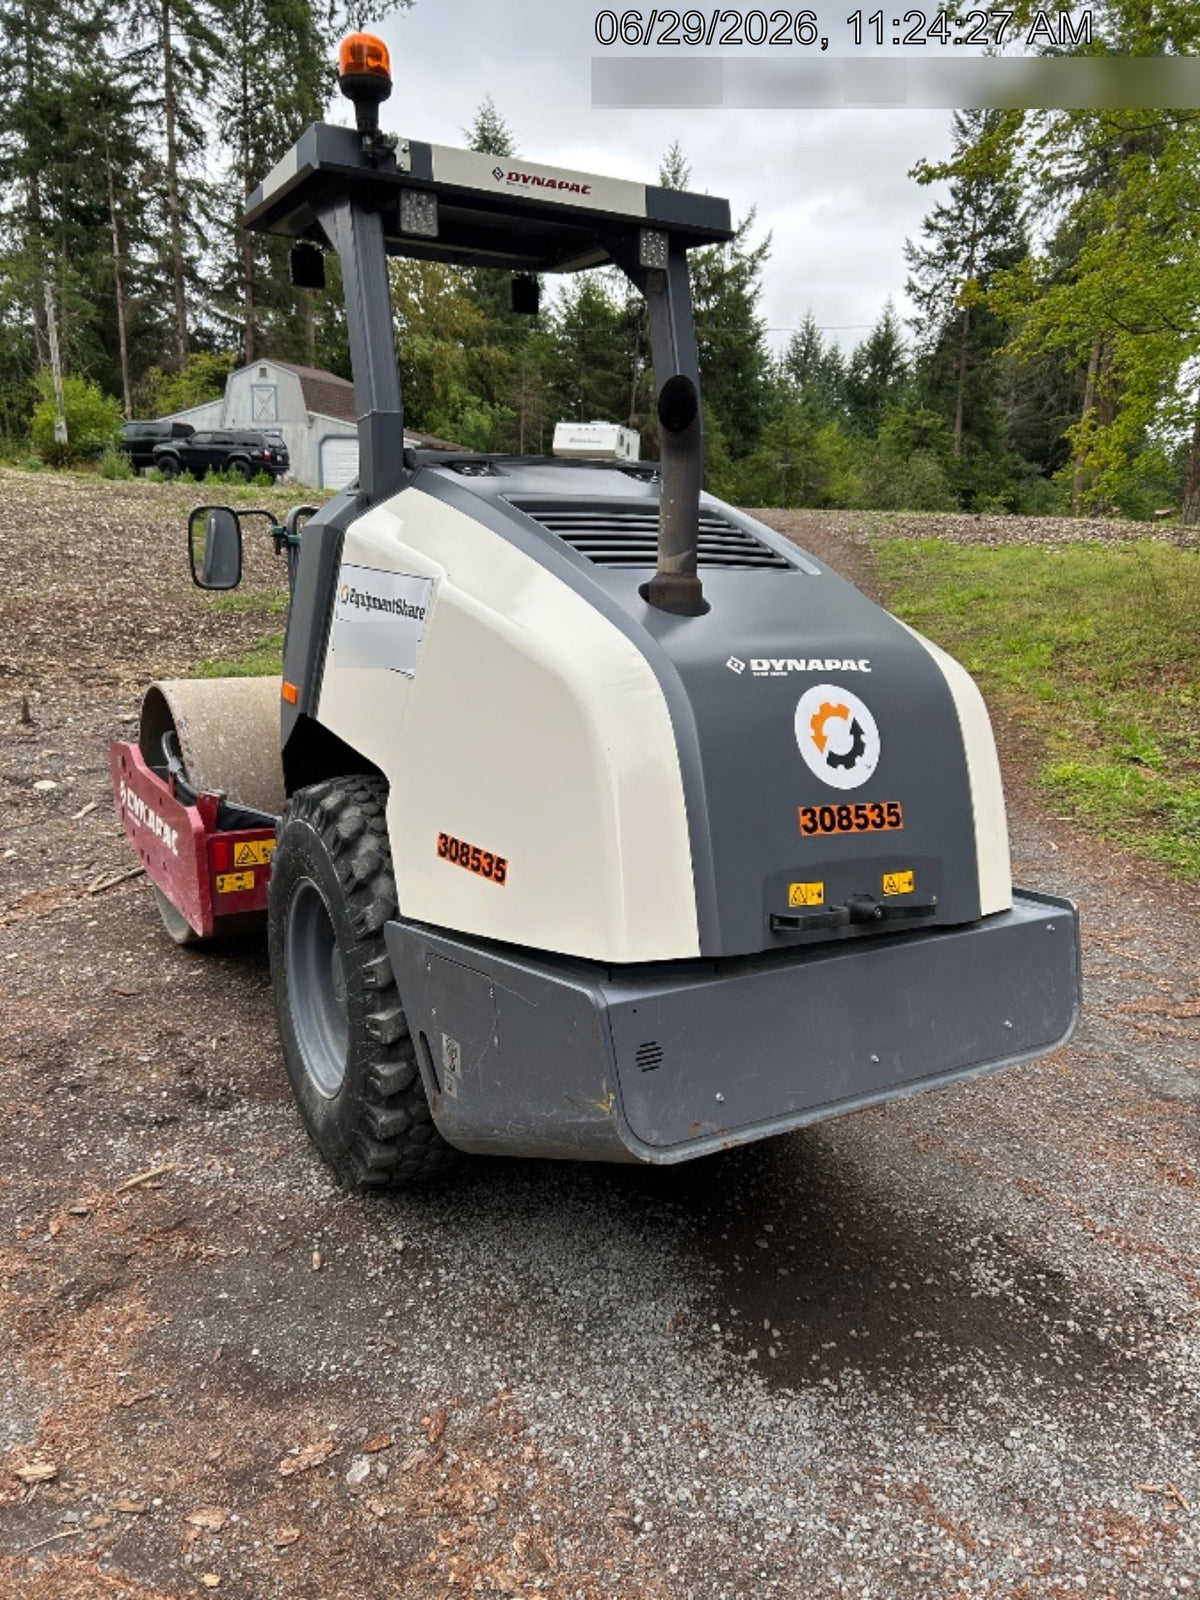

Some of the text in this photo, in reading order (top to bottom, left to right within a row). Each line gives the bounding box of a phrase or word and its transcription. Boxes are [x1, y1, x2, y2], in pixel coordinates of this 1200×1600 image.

[506, 171, 592, 195] DYNAPAC
[750, 658, 872, 673] DYNAPAC
[801, 803, 901, 834] 308535
[438, 832, 507, 883] 308535
